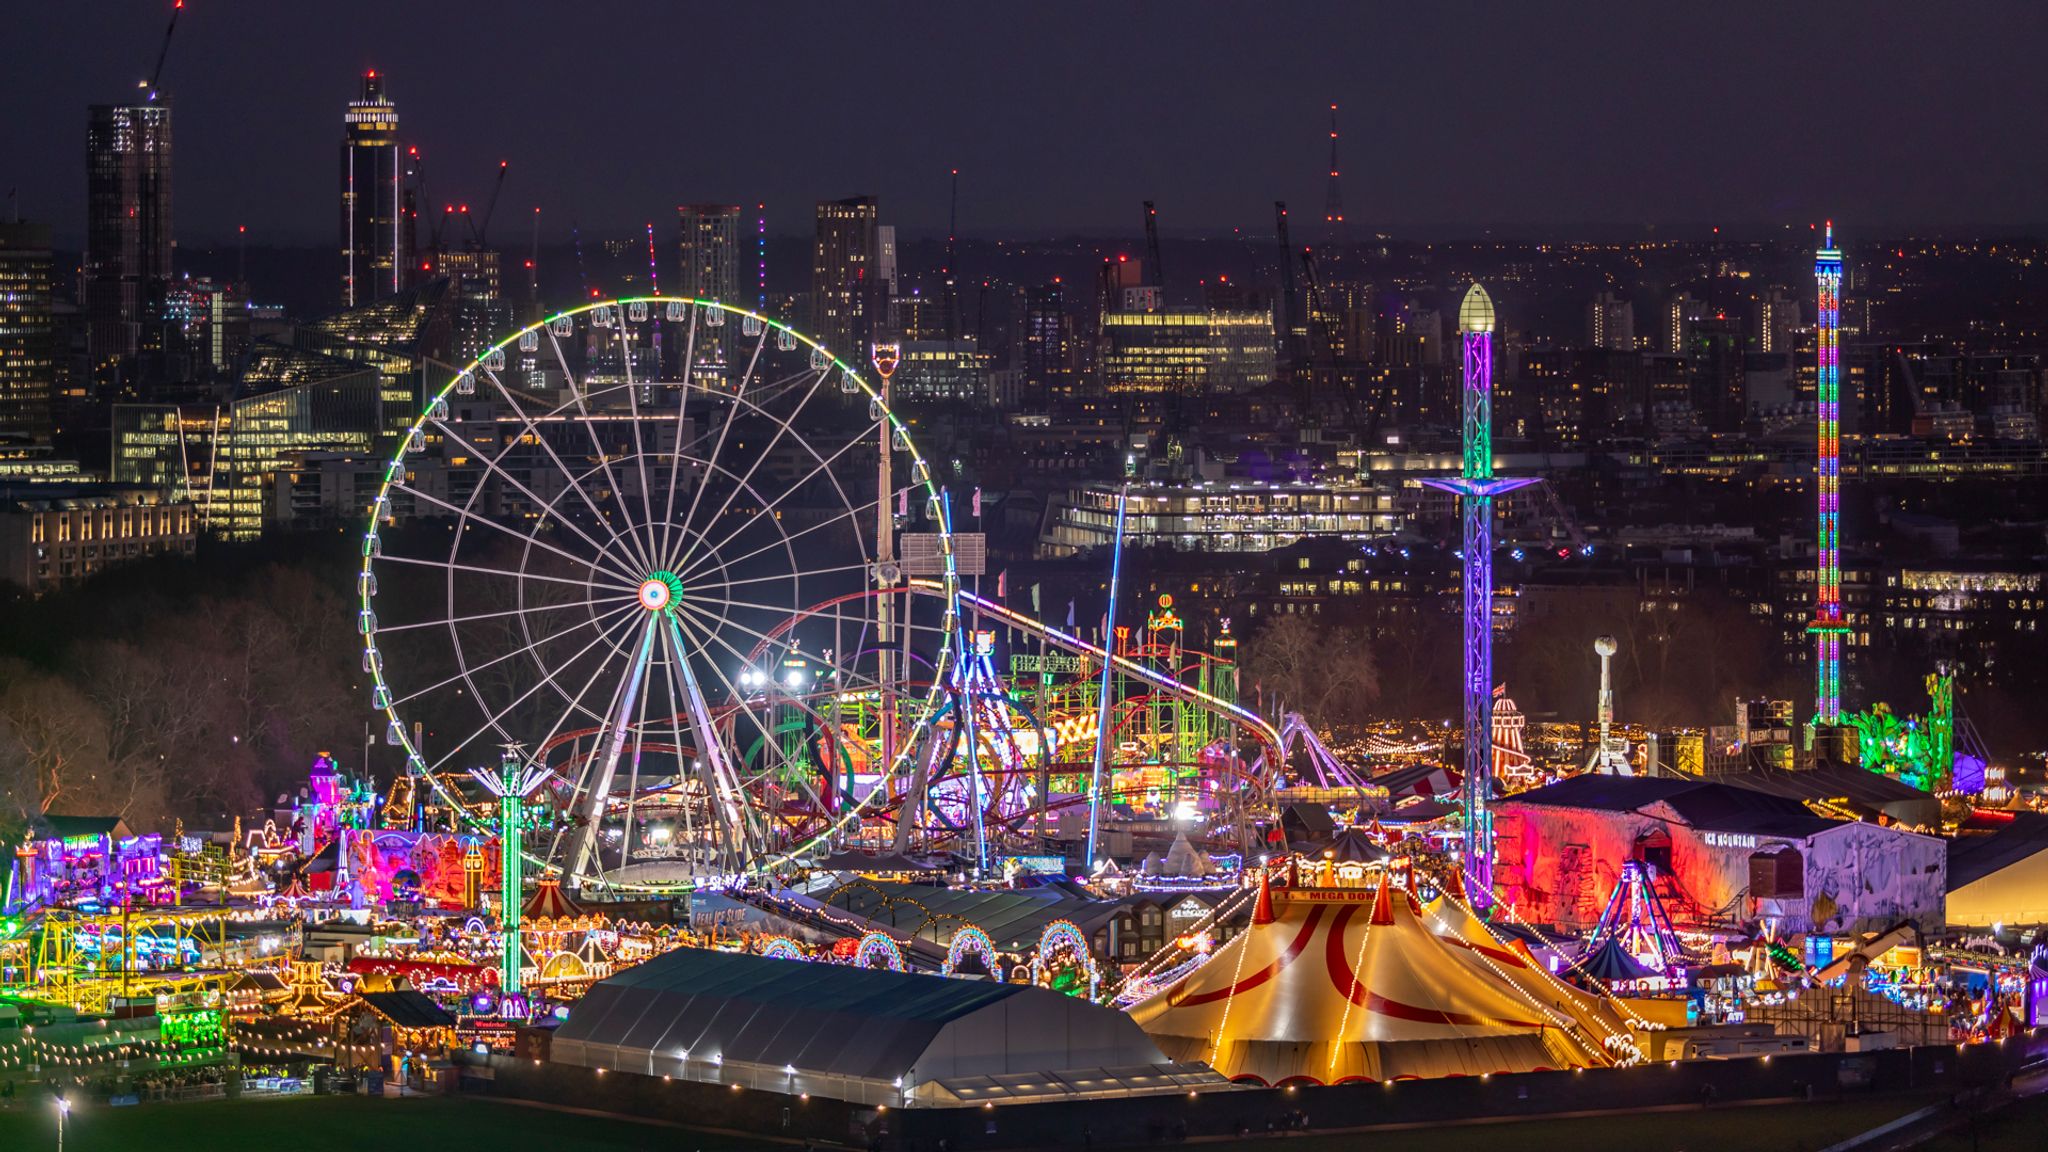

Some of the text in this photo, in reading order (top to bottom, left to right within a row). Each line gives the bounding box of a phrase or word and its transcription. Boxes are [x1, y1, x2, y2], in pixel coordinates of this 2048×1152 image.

[1750, 729, 1790, 743] DAEMNIUM
[1705, 833, 1755, 848] ICE MOUNTAIN
[1310, 892, 1345, 900] MEGA
[1348, 892, 1377, 900] DOM
[696, 912, 712, 927] REAL
